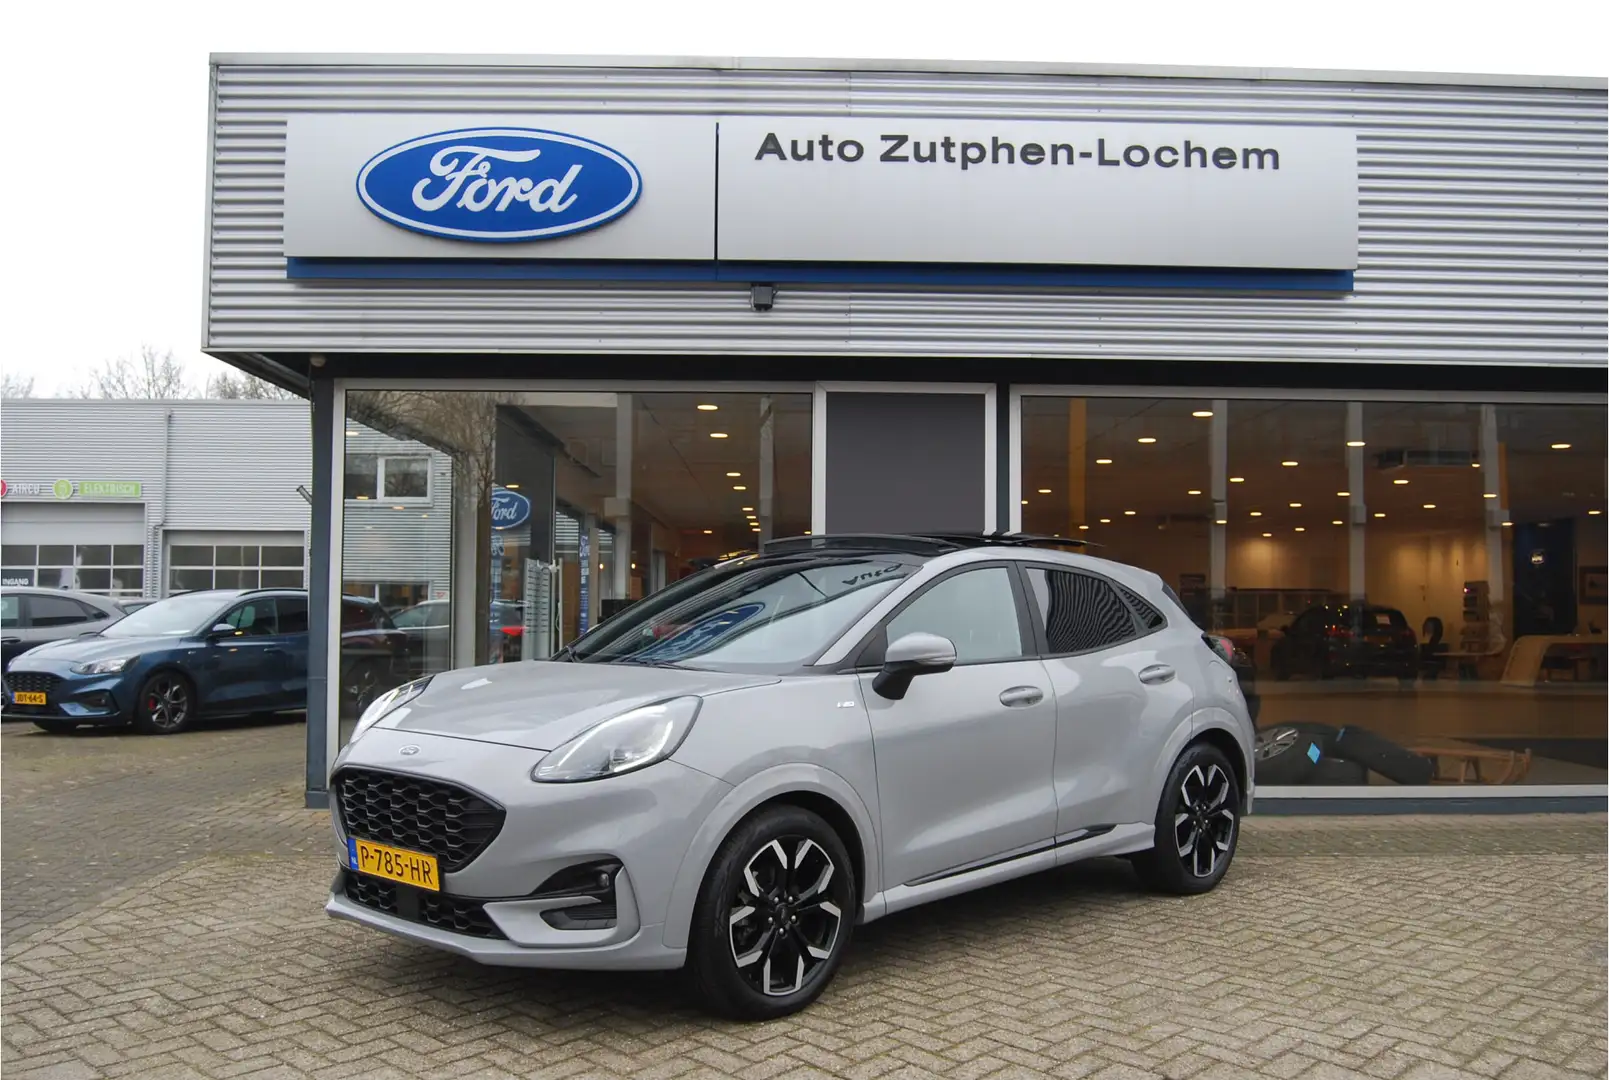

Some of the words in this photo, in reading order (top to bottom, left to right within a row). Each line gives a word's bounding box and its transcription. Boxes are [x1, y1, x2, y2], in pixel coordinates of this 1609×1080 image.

[754, 132, 866, 163] Auto
[878, 134, 1281, 171] Zutphen-Lochem
[411, 145, 584, 213] Ford
[360, 845, 433, 885] P-785-HR
